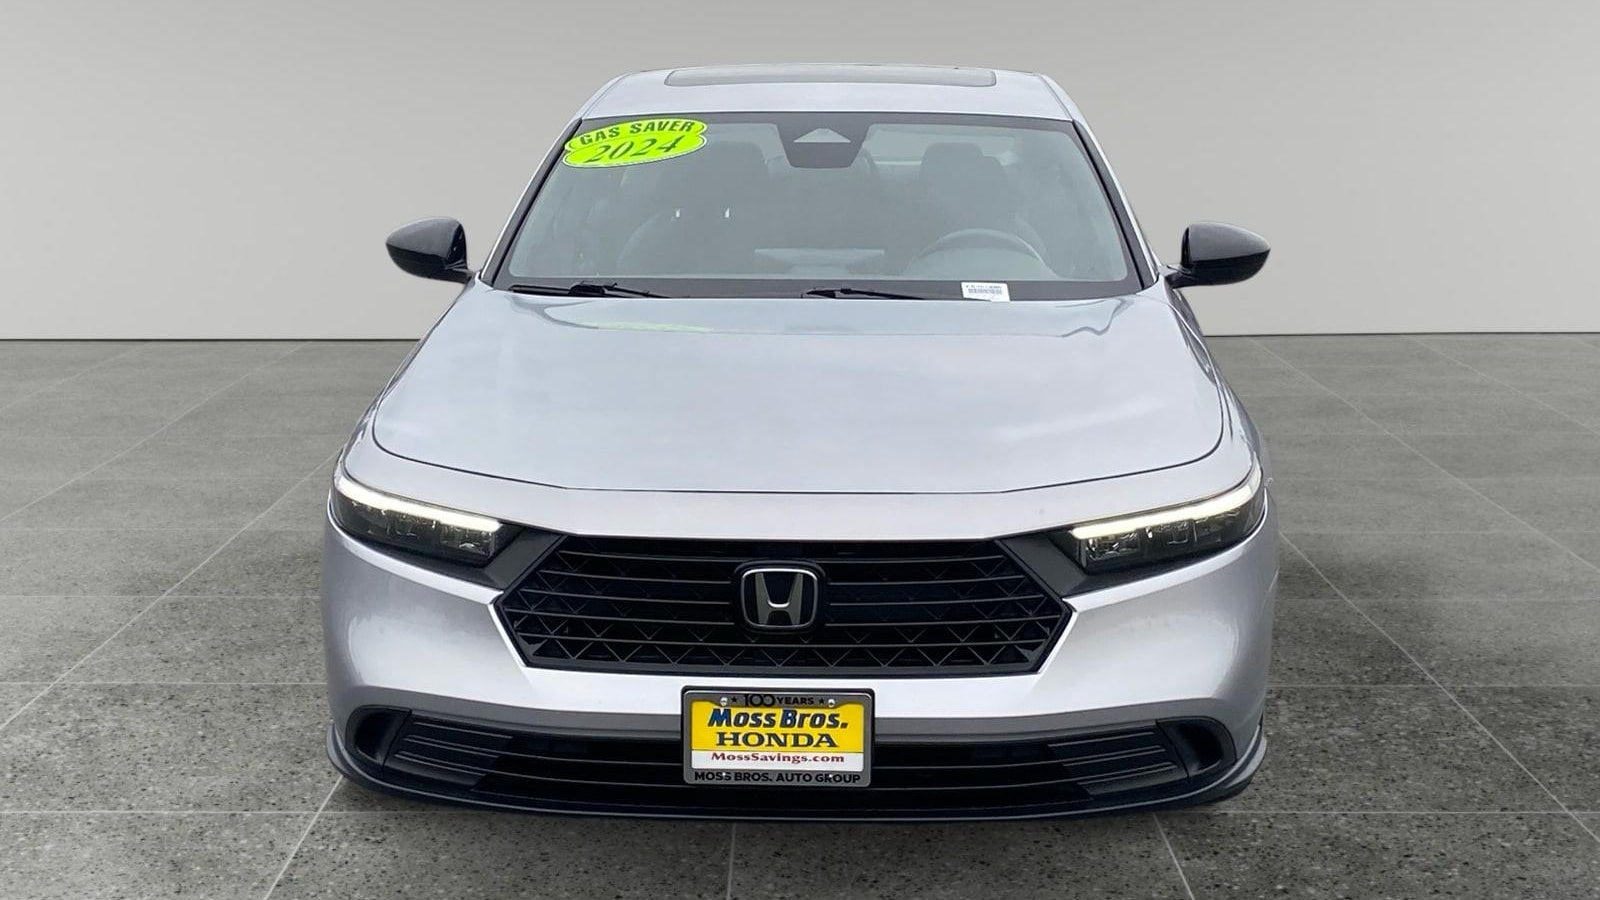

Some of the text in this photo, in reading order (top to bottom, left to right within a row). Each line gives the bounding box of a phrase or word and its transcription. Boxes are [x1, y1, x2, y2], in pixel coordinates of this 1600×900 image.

[580, 121, 695, 145] GAS SAVER
[584, 135, 684, 162] 2024
[744, 694, 814, 707] 100 YEARS
[708, 708, 848, 729] Moss Bros.
[717, 732, 838, 748] HONDA
[711, 752, 845, 764] MossSavings.com
[694, 771, 861, 783] MOSS BROS. AUTO GROUP
